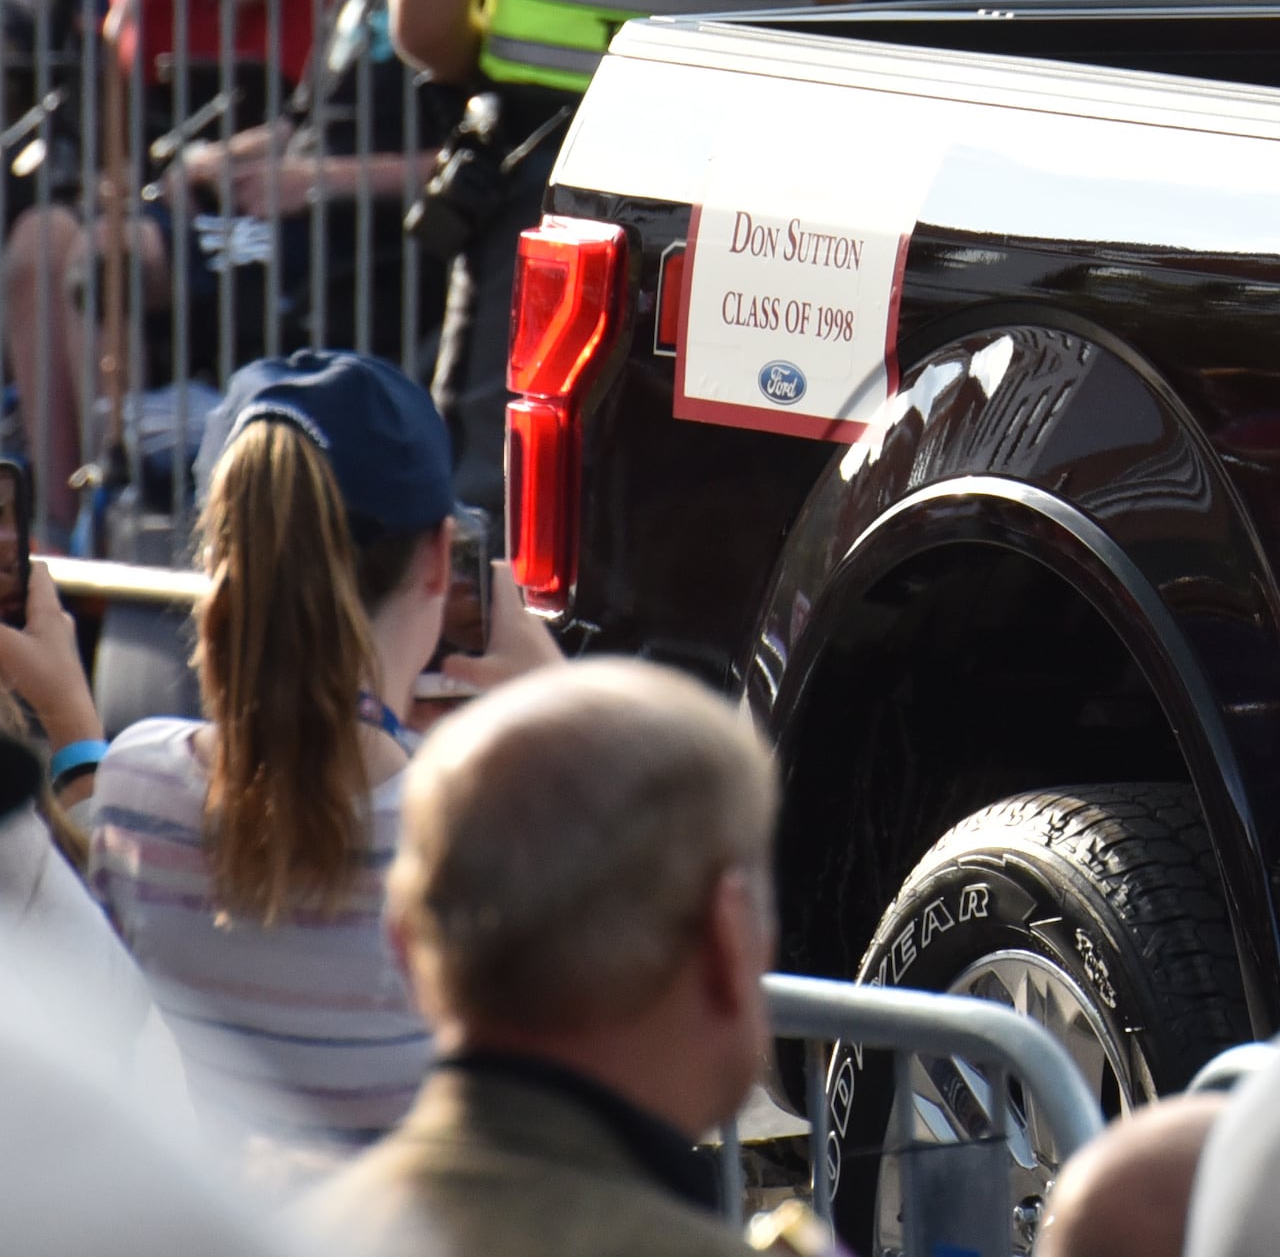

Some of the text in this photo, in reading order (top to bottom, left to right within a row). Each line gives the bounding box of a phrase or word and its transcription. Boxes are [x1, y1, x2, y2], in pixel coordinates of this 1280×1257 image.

[729, 210, 864, 272] DON SUTTON
[722, 291, 854, 343] CLASS OF 1998
[766, 366, 797, 399] Ford
